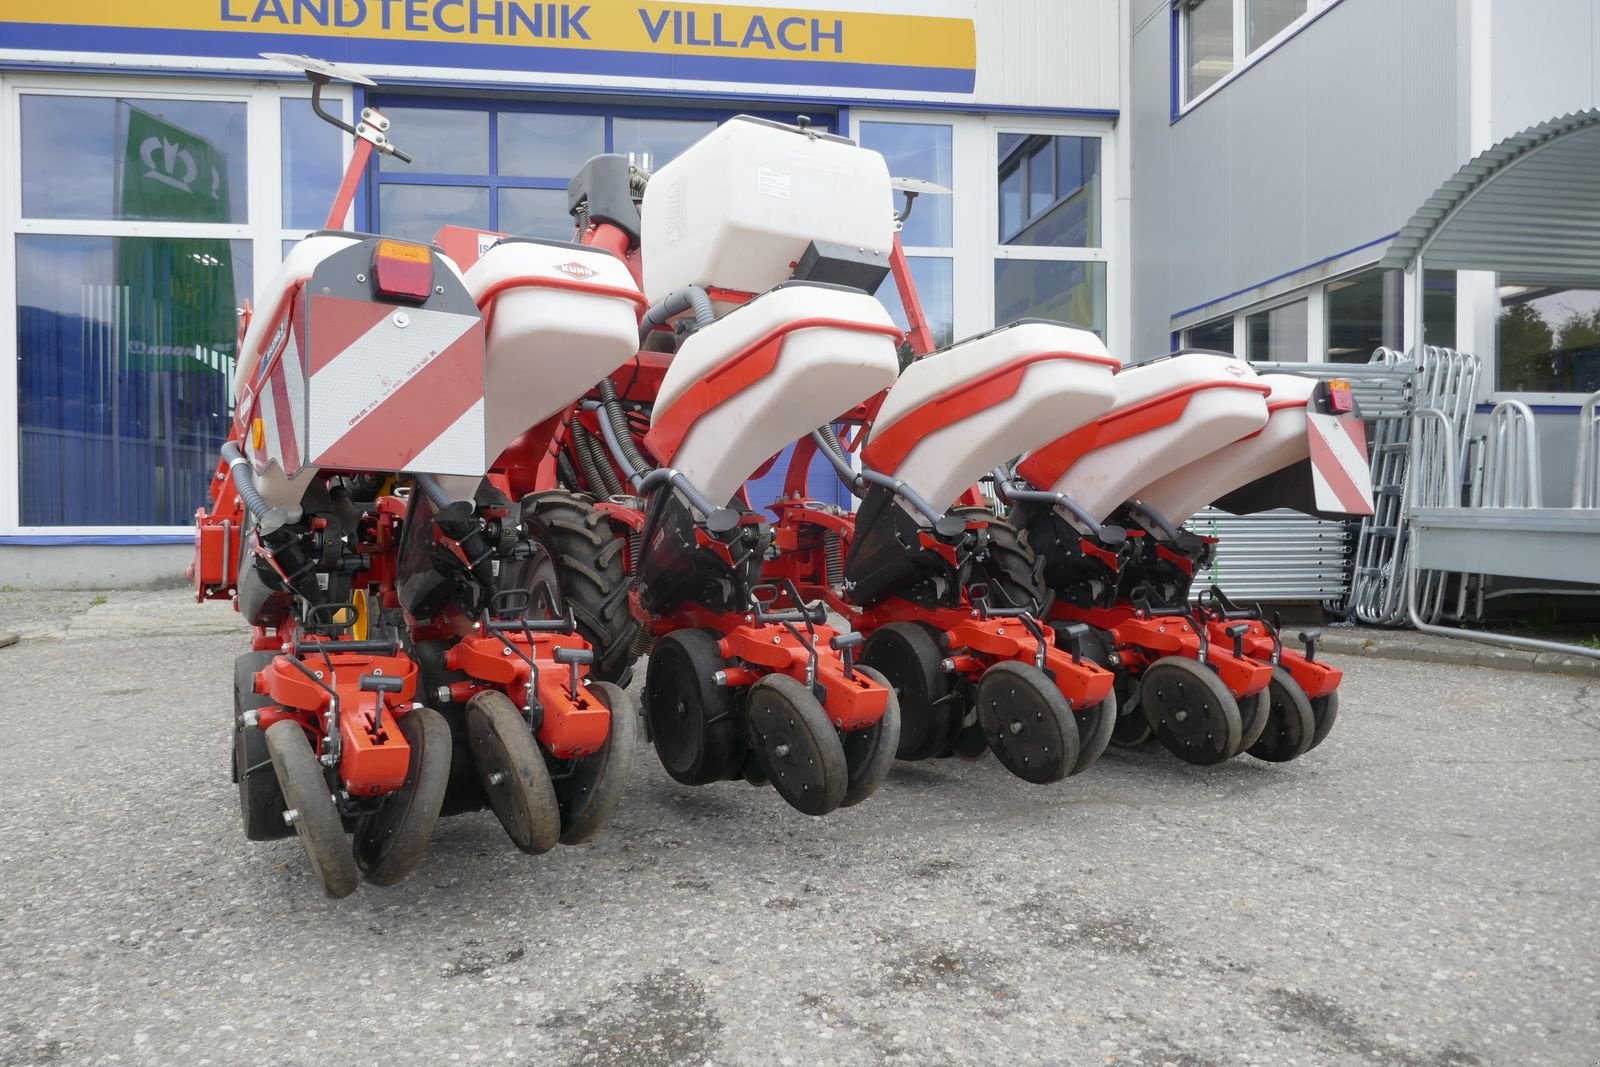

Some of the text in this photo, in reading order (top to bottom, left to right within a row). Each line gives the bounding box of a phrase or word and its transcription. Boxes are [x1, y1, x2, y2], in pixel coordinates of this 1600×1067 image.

[220, 0, 843, 54] LANDTECHNIK VILLACH
[560, 264, 593, 276] KUHN
